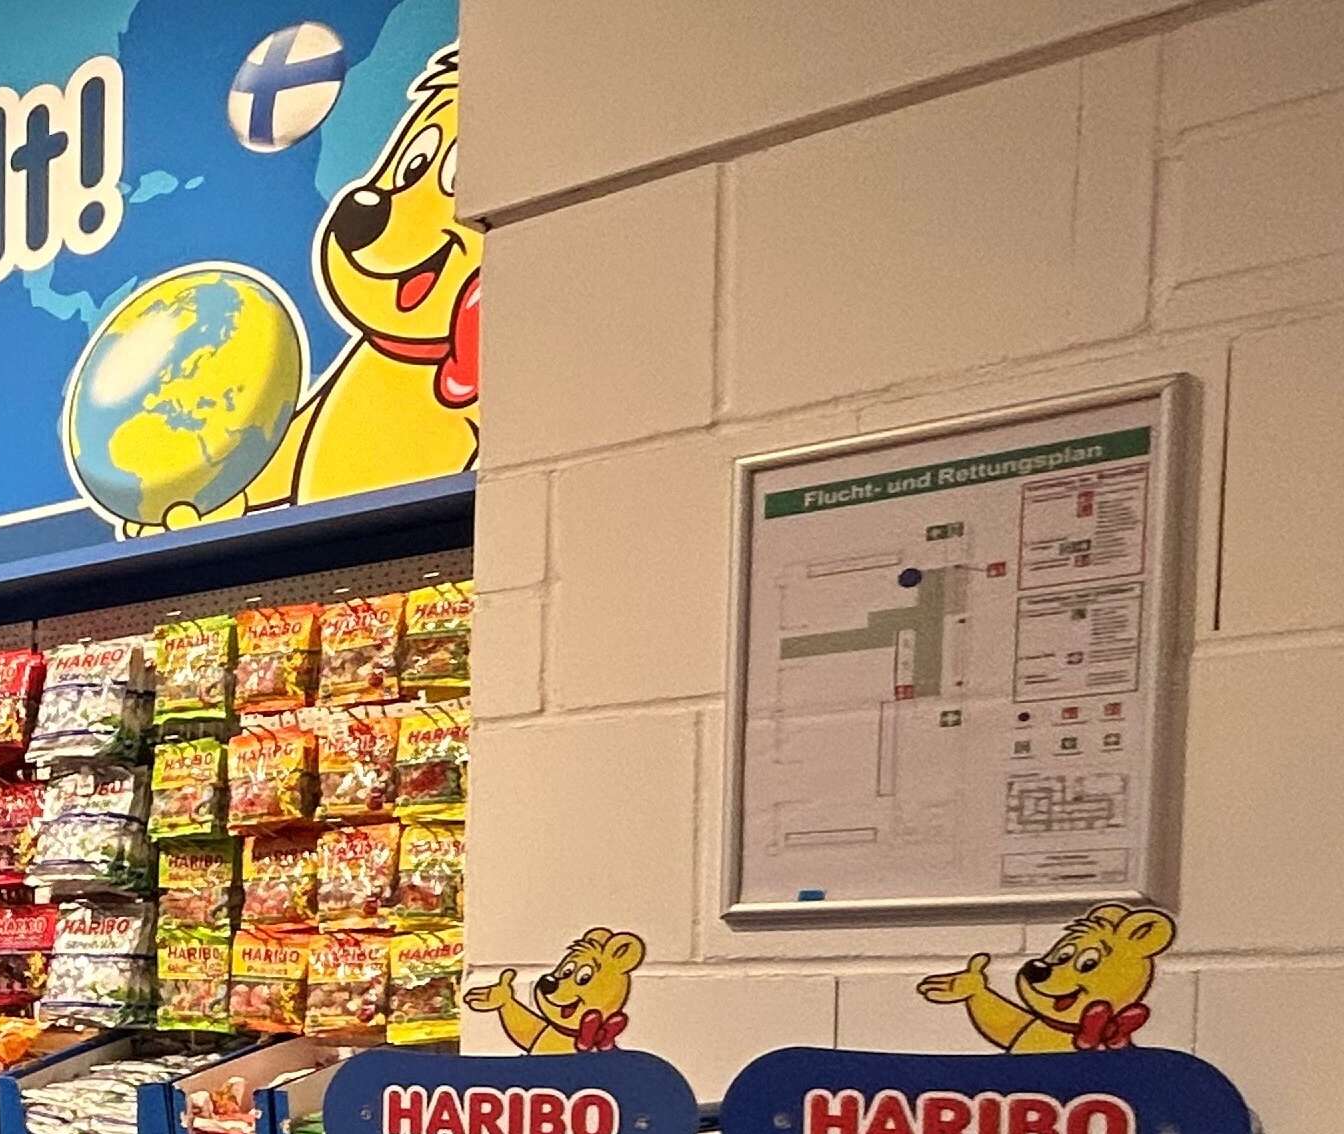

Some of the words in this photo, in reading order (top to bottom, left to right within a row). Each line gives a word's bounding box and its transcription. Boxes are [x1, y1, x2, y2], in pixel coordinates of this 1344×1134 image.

[804, 483, 882, 508] Flucht-
[887, 471, 932, 495] und
[938, 444, 1103, 484] Rettungsplan
[65, 917, 130, 935] HARIBO
